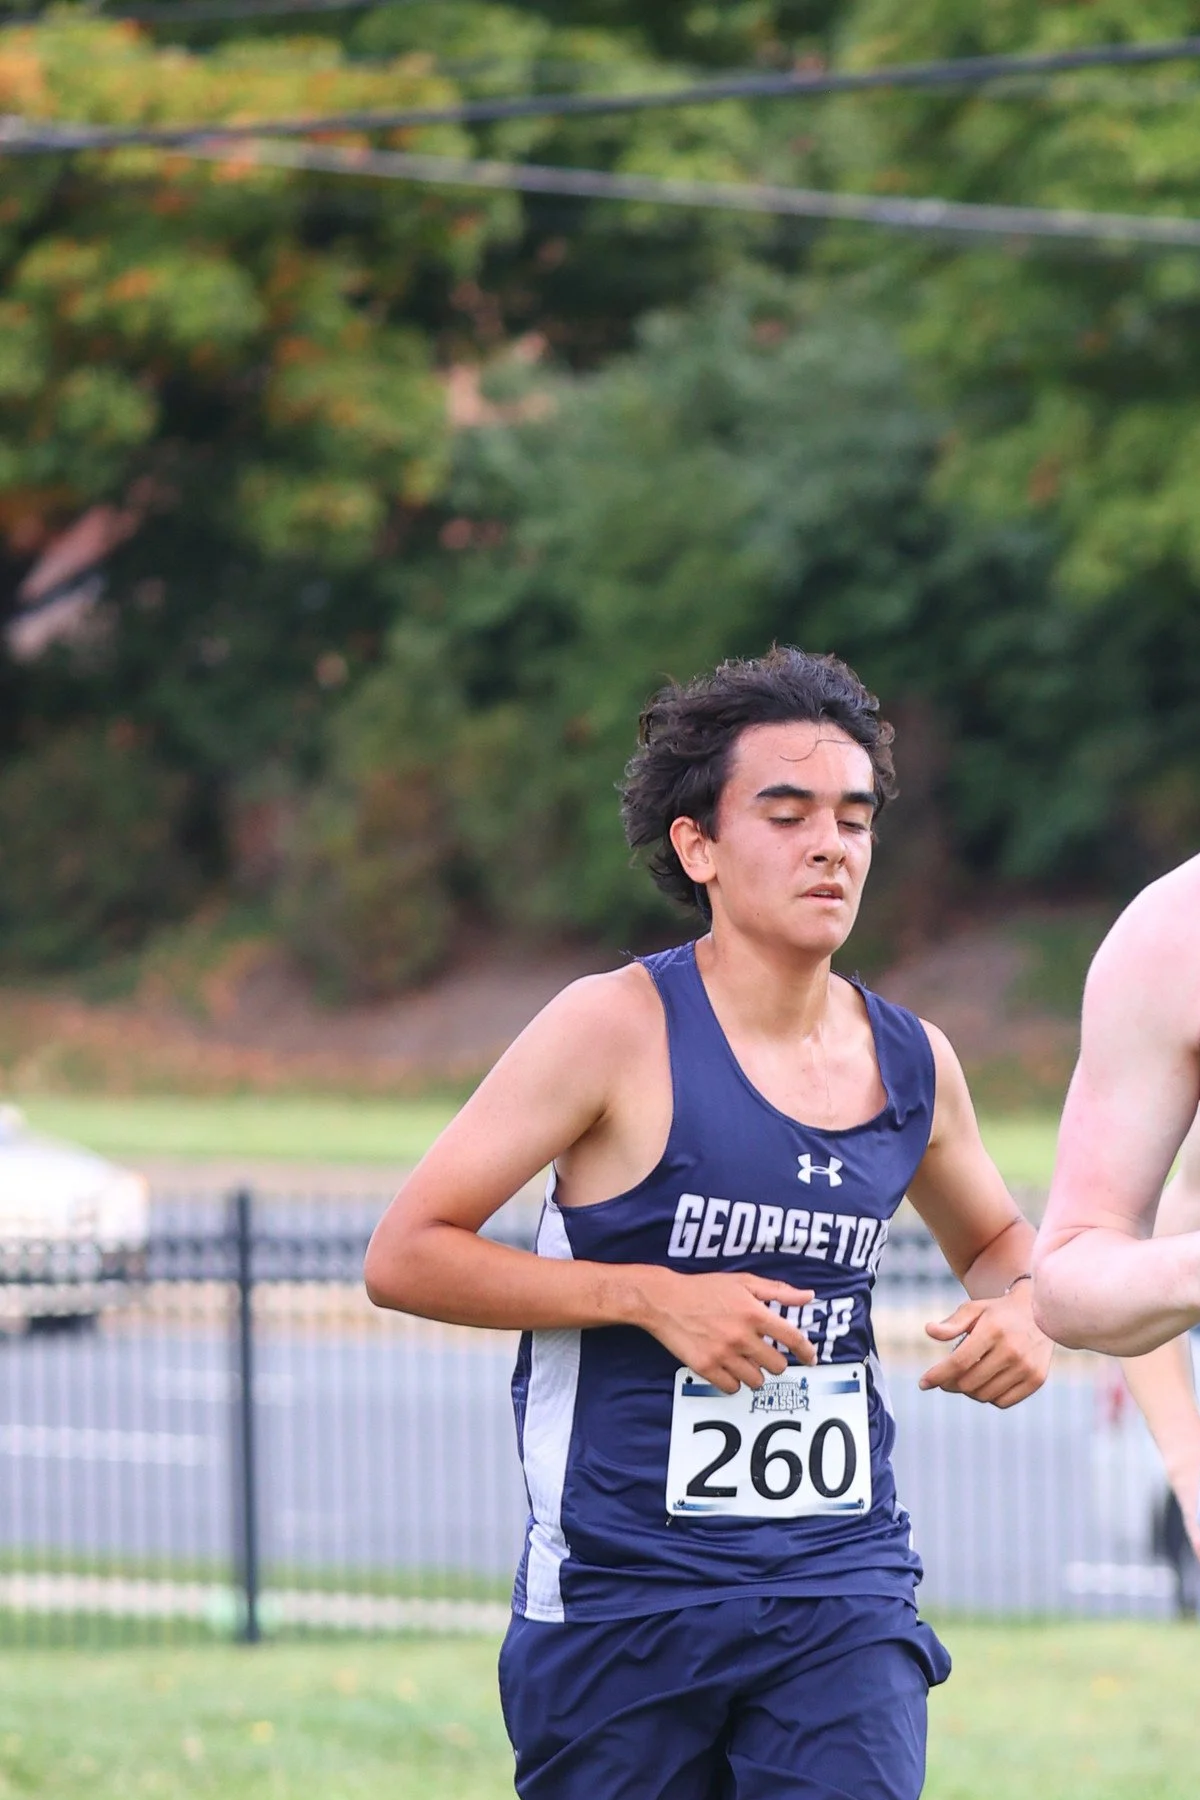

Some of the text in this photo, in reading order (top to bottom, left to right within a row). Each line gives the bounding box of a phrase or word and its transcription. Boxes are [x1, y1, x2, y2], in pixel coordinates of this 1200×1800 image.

[666, 1192, 889, 1279] GEORGETO
[756, 1395, 806, 1411] CLASSIC
[685, 1417, 857, 1501] 260
